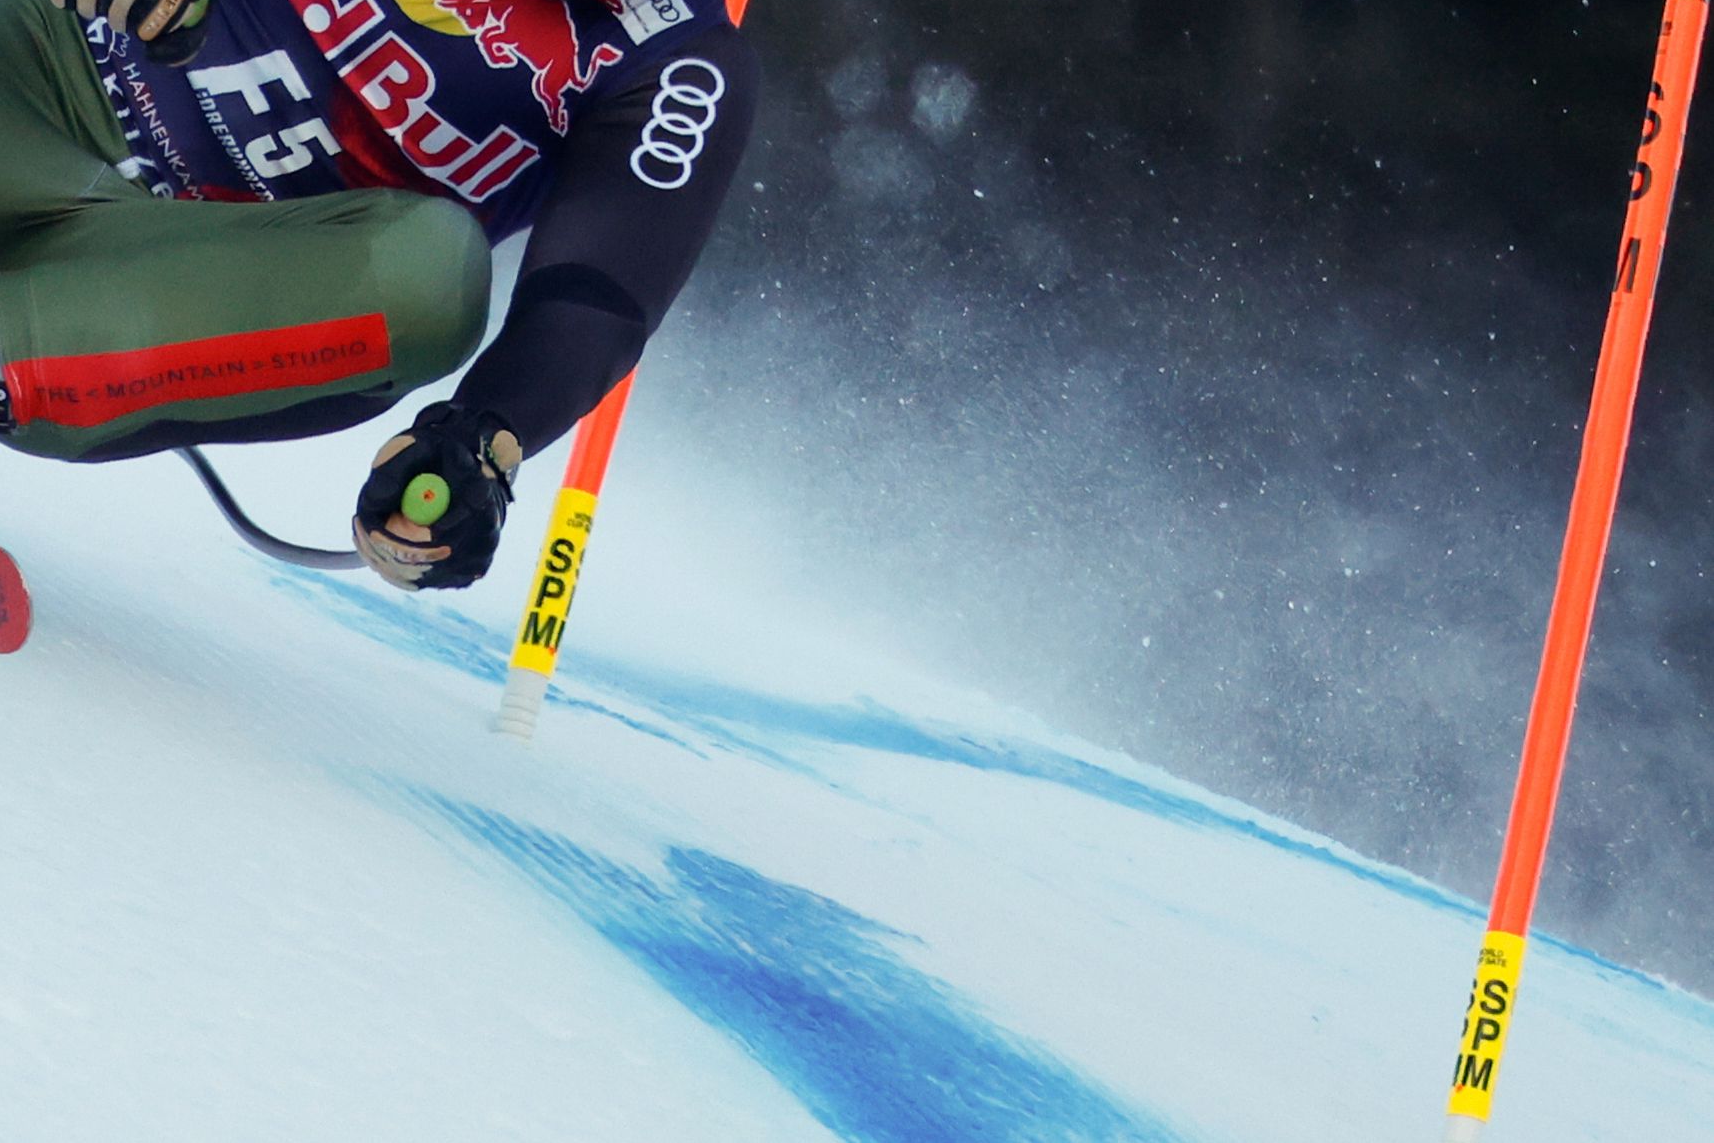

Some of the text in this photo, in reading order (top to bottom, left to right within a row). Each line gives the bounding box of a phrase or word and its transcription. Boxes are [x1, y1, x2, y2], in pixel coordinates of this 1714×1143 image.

[186, 49, 343, 179] F5
[337, 30, 541, 203] Bull
[105, 360, 246, 399] MOUNTAIN
[271, 340, 367, 370] STUDIO
